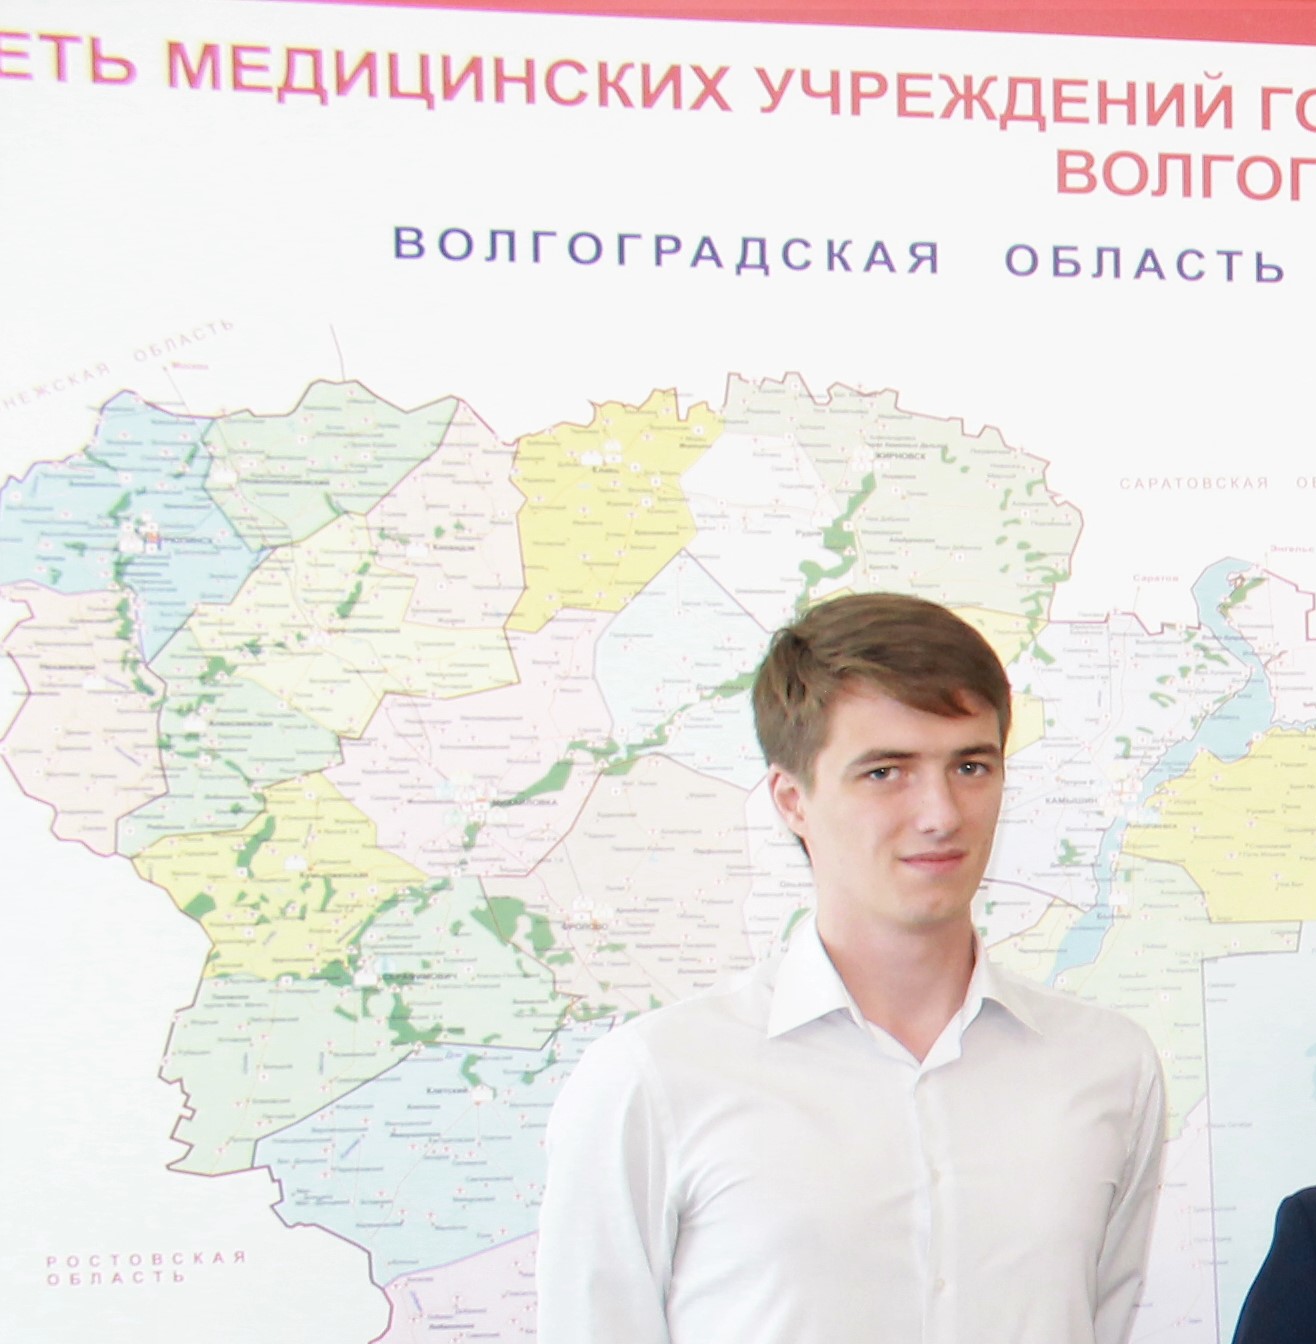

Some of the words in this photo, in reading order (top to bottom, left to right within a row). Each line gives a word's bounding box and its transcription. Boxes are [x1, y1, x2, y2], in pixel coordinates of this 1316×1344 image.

[163, 38, 732, 112] МЕДИЦИНСКИХ
[754, 67, 1233, 133] УЧРЕЖДЕНИЙ
[393, 225, 938, 277] ВОЛГОГРАДСКАЯ
[1005, 243, 1284, 283] ОБЛАСТЬ
[133, 318, 235, 363] ОБЛАСТЬ
[1119, 475, 1269, 491] САРАТОВСКАЯ
[1132, 573, 1180, 584] Саратов
[45, 1249, 248, 1268] РОСТОВСКАЯ
[46, 1269, 187, 1287] ОБЛАСТЬ
